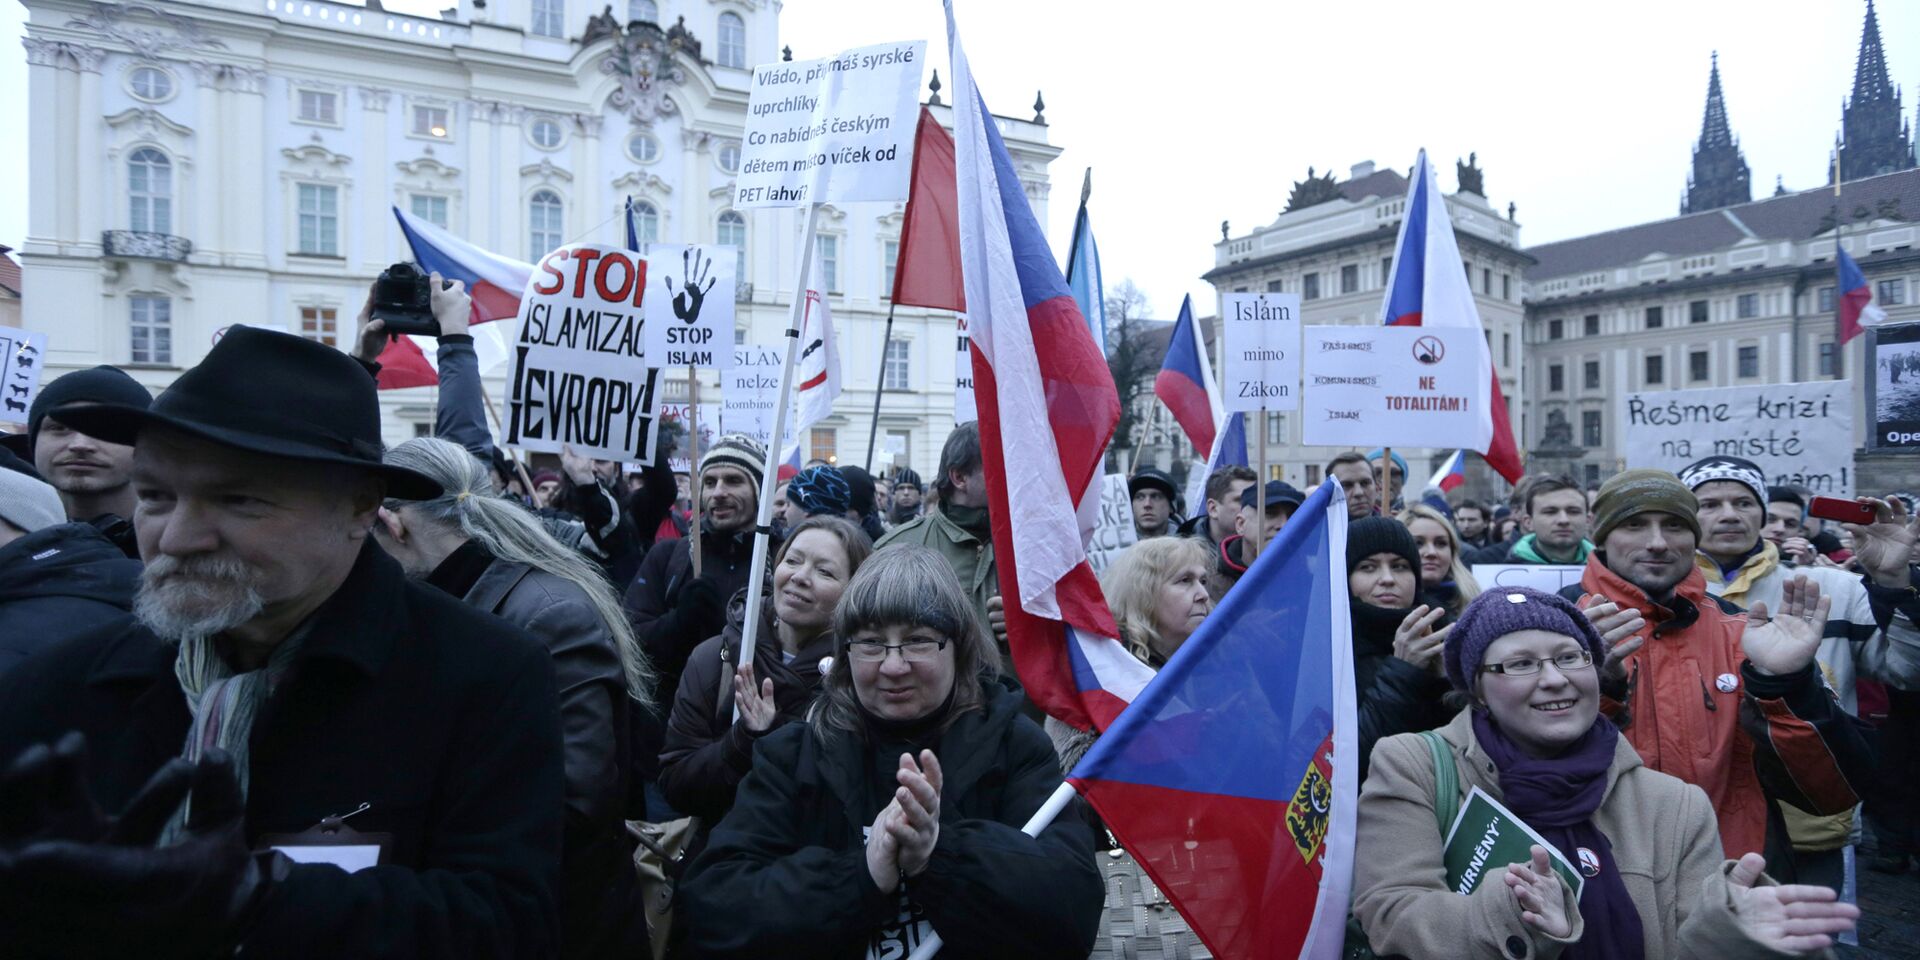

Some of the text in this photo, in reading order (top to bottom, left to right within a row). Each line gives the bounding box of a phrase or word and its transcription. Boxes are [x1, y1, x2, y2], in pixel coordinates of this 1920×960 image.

[758, 69, 801, 86] Vládo,
[862, 46, 914, 69] syrské
[748, 114, 890, 145] Co nabídneš českým
[743, 143, 898, 174] dětem místo víček od
[739, 184, 808, 203] PET lahví?
[1234, 300, 1291, 322] Islám
[666, 327, 713, 344] STOP
[667, 351, 713, 365] ISLAM
[1243, 346, 1285, 362] mimo
[736, 374, 779, 389] nelze
[1239, 380, 1289, 398] Zákon
[1418, 376, 1435, 390] NE
[1385, 394, 1460, 412] TOTALITÁM
[1628, 394, 1831, 425] Řešme krizi
[1661, 430, 1805, 458] na místě
